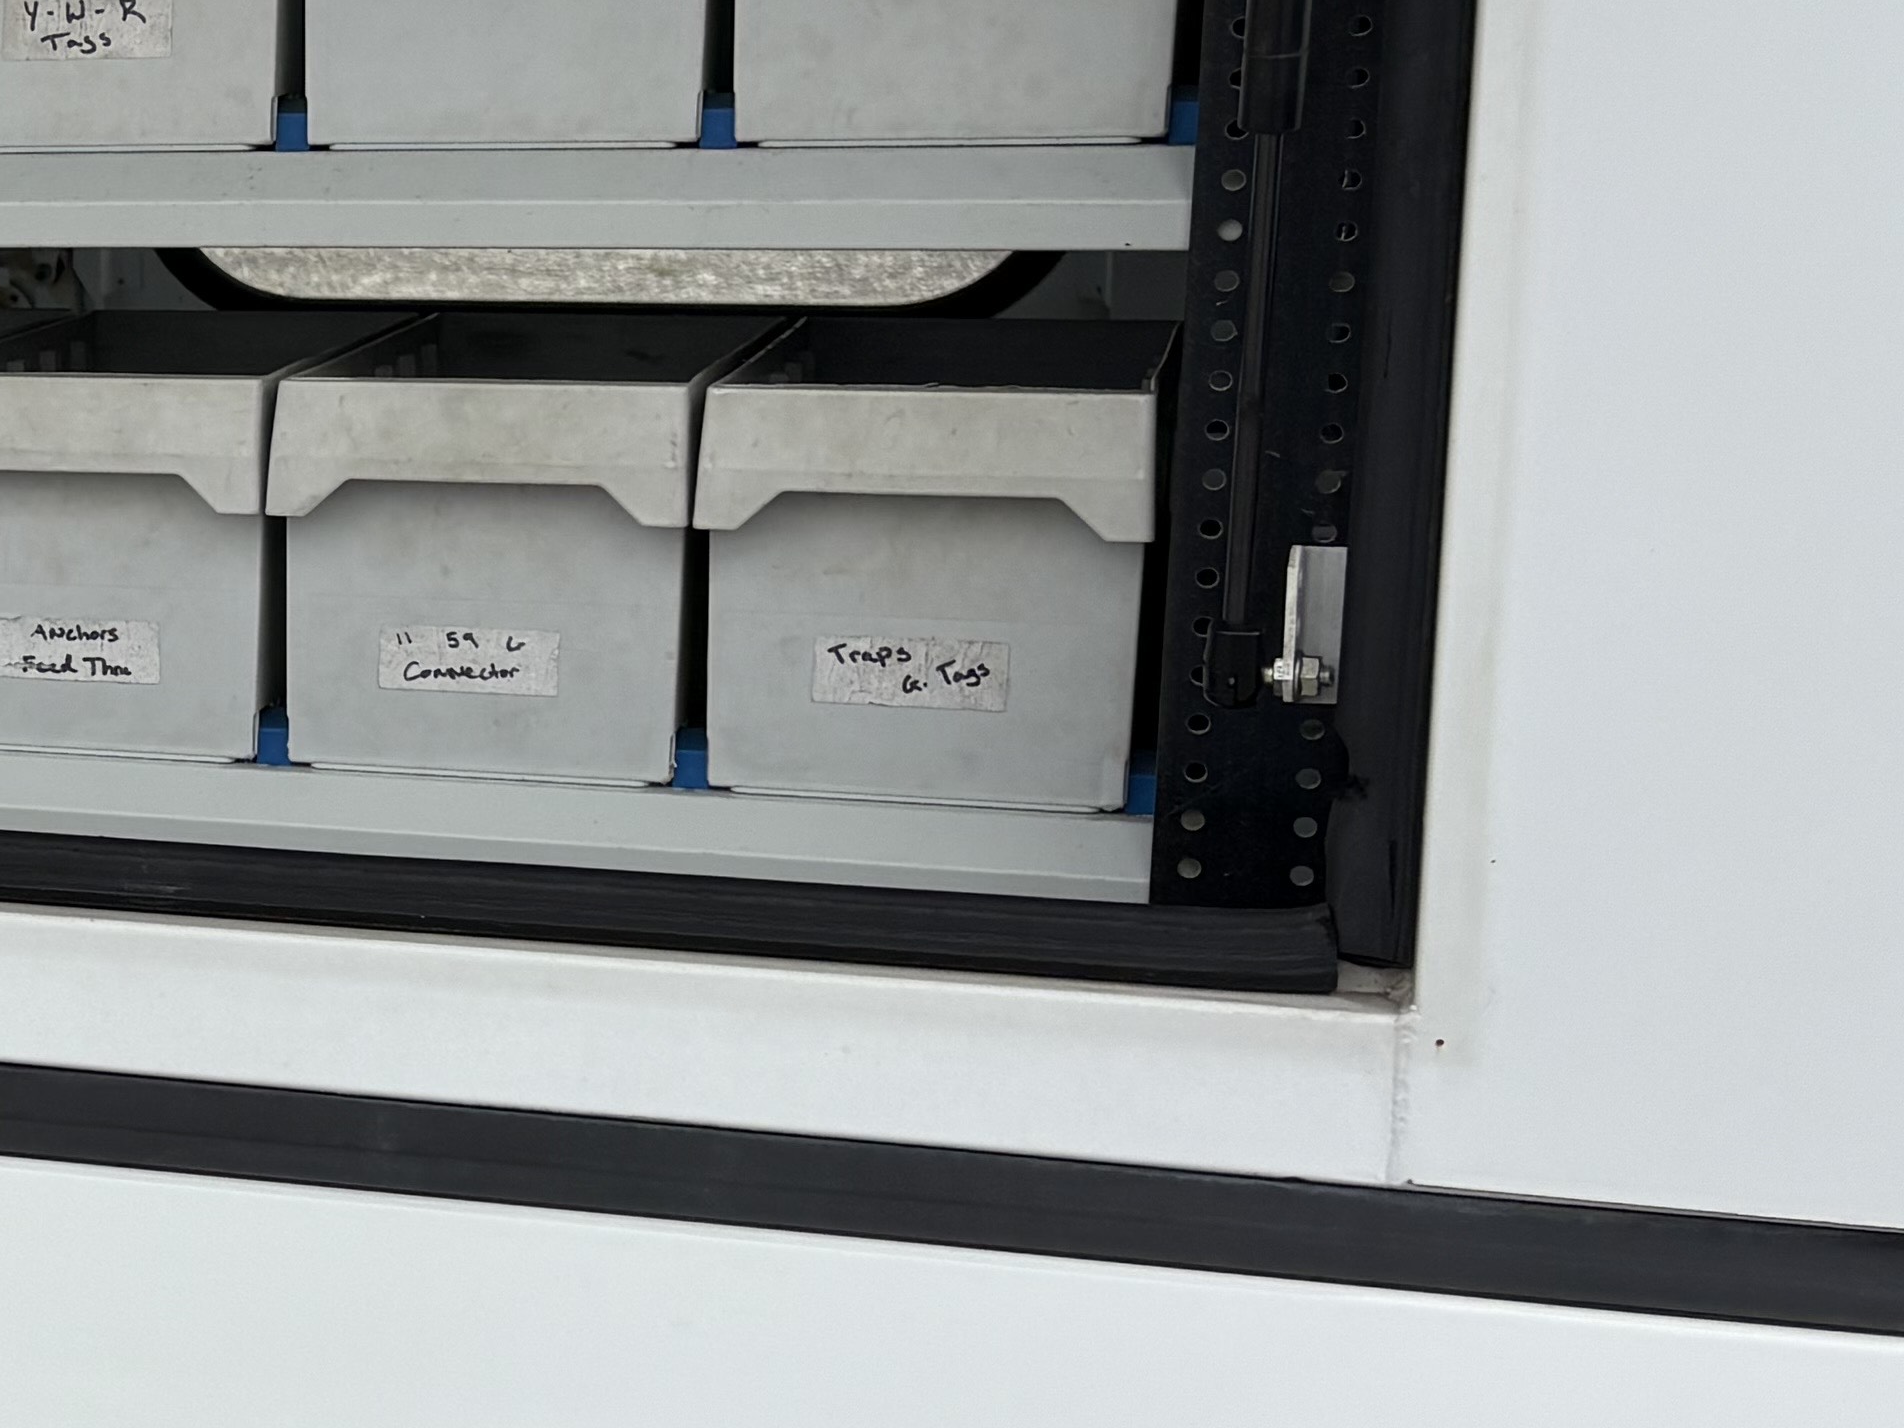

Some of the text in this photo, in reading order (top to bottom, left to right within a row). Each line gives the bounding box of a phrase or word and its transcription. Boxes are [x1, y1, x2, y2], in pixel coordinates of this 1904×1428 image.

[40, 31, 112, 55] Tags
[446, 631, 480, 649] 59
[827, 642, 912, 668] Traps
[935, 659, 991, 688] Tags
